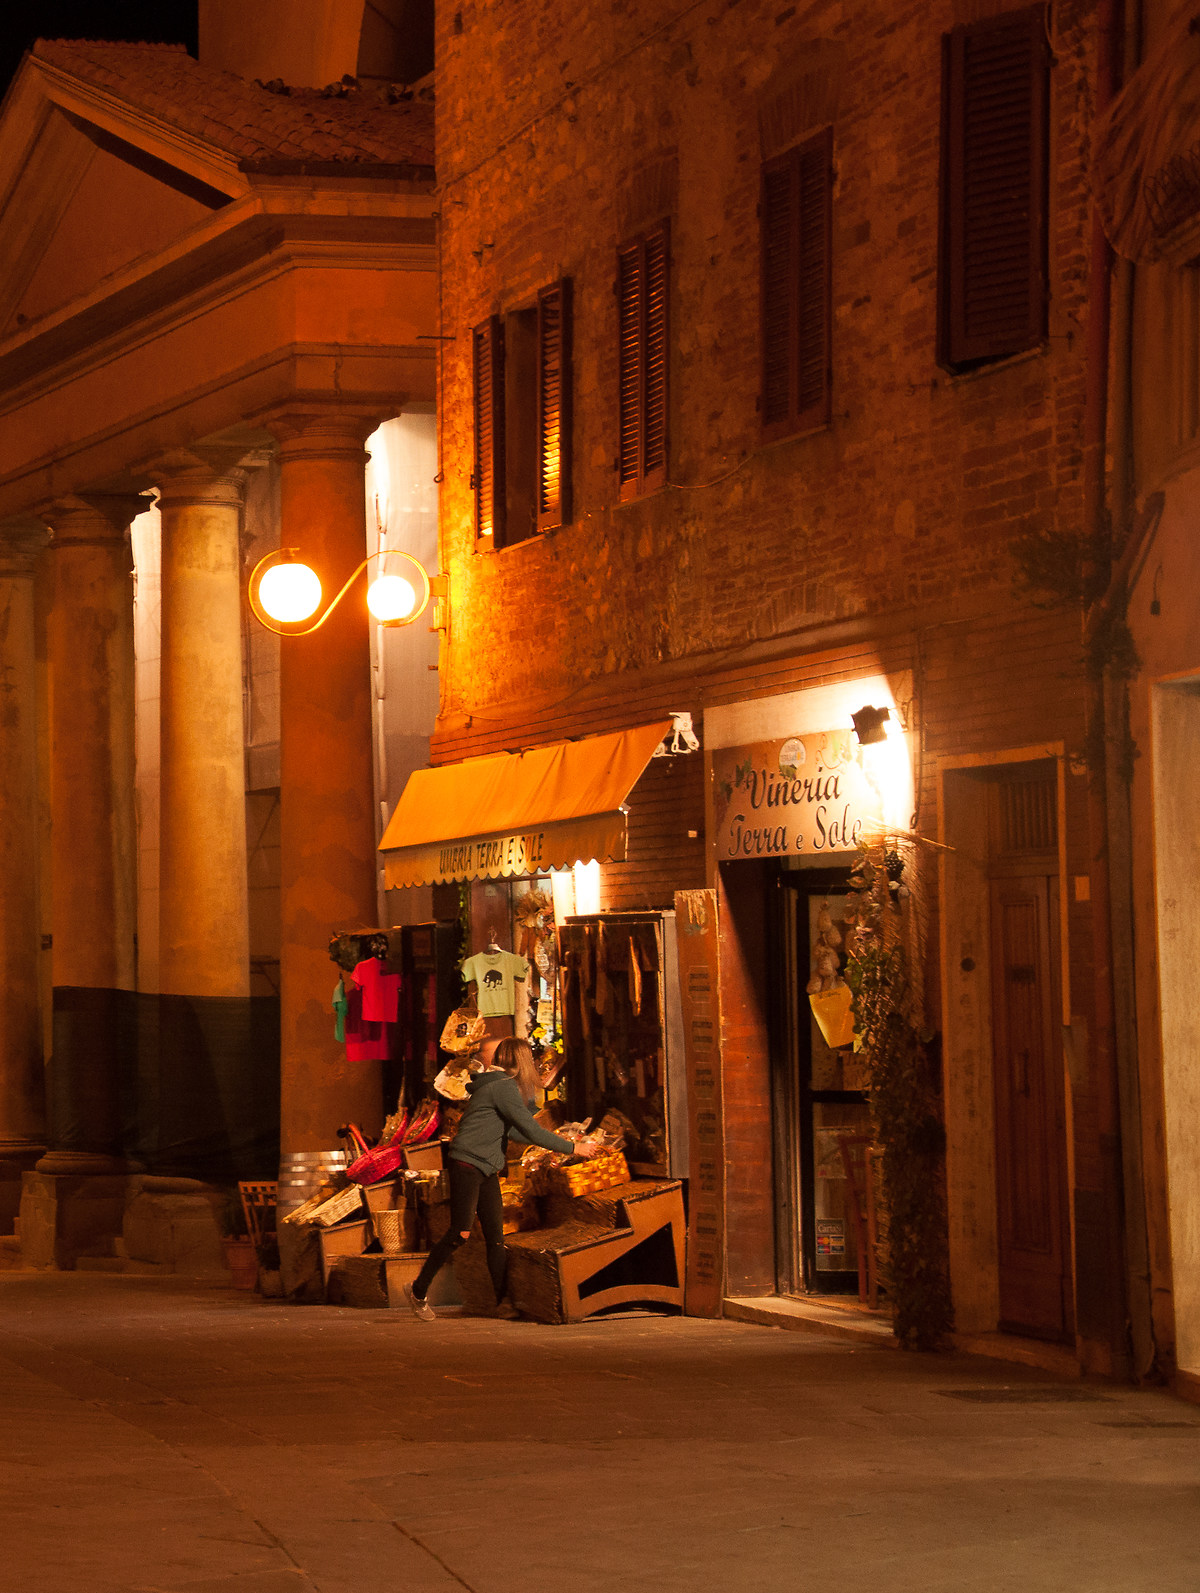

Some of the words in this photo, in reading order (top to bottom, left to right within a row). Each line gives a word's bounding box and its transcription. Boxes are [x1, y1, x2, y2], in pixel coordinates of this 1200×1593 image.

[746, 767, 840, 810] Vineria
[728, 814, 788, 857] Terra
[795, 834, 804, 850] e
[813, 803, 862, 849] Sole
[439, 845, 473, 874] UMBRIA
[476, 840, 503, 869] TERRA
[507, 838, 515, 865] E
[518, 833, 545, 863] SOLE
